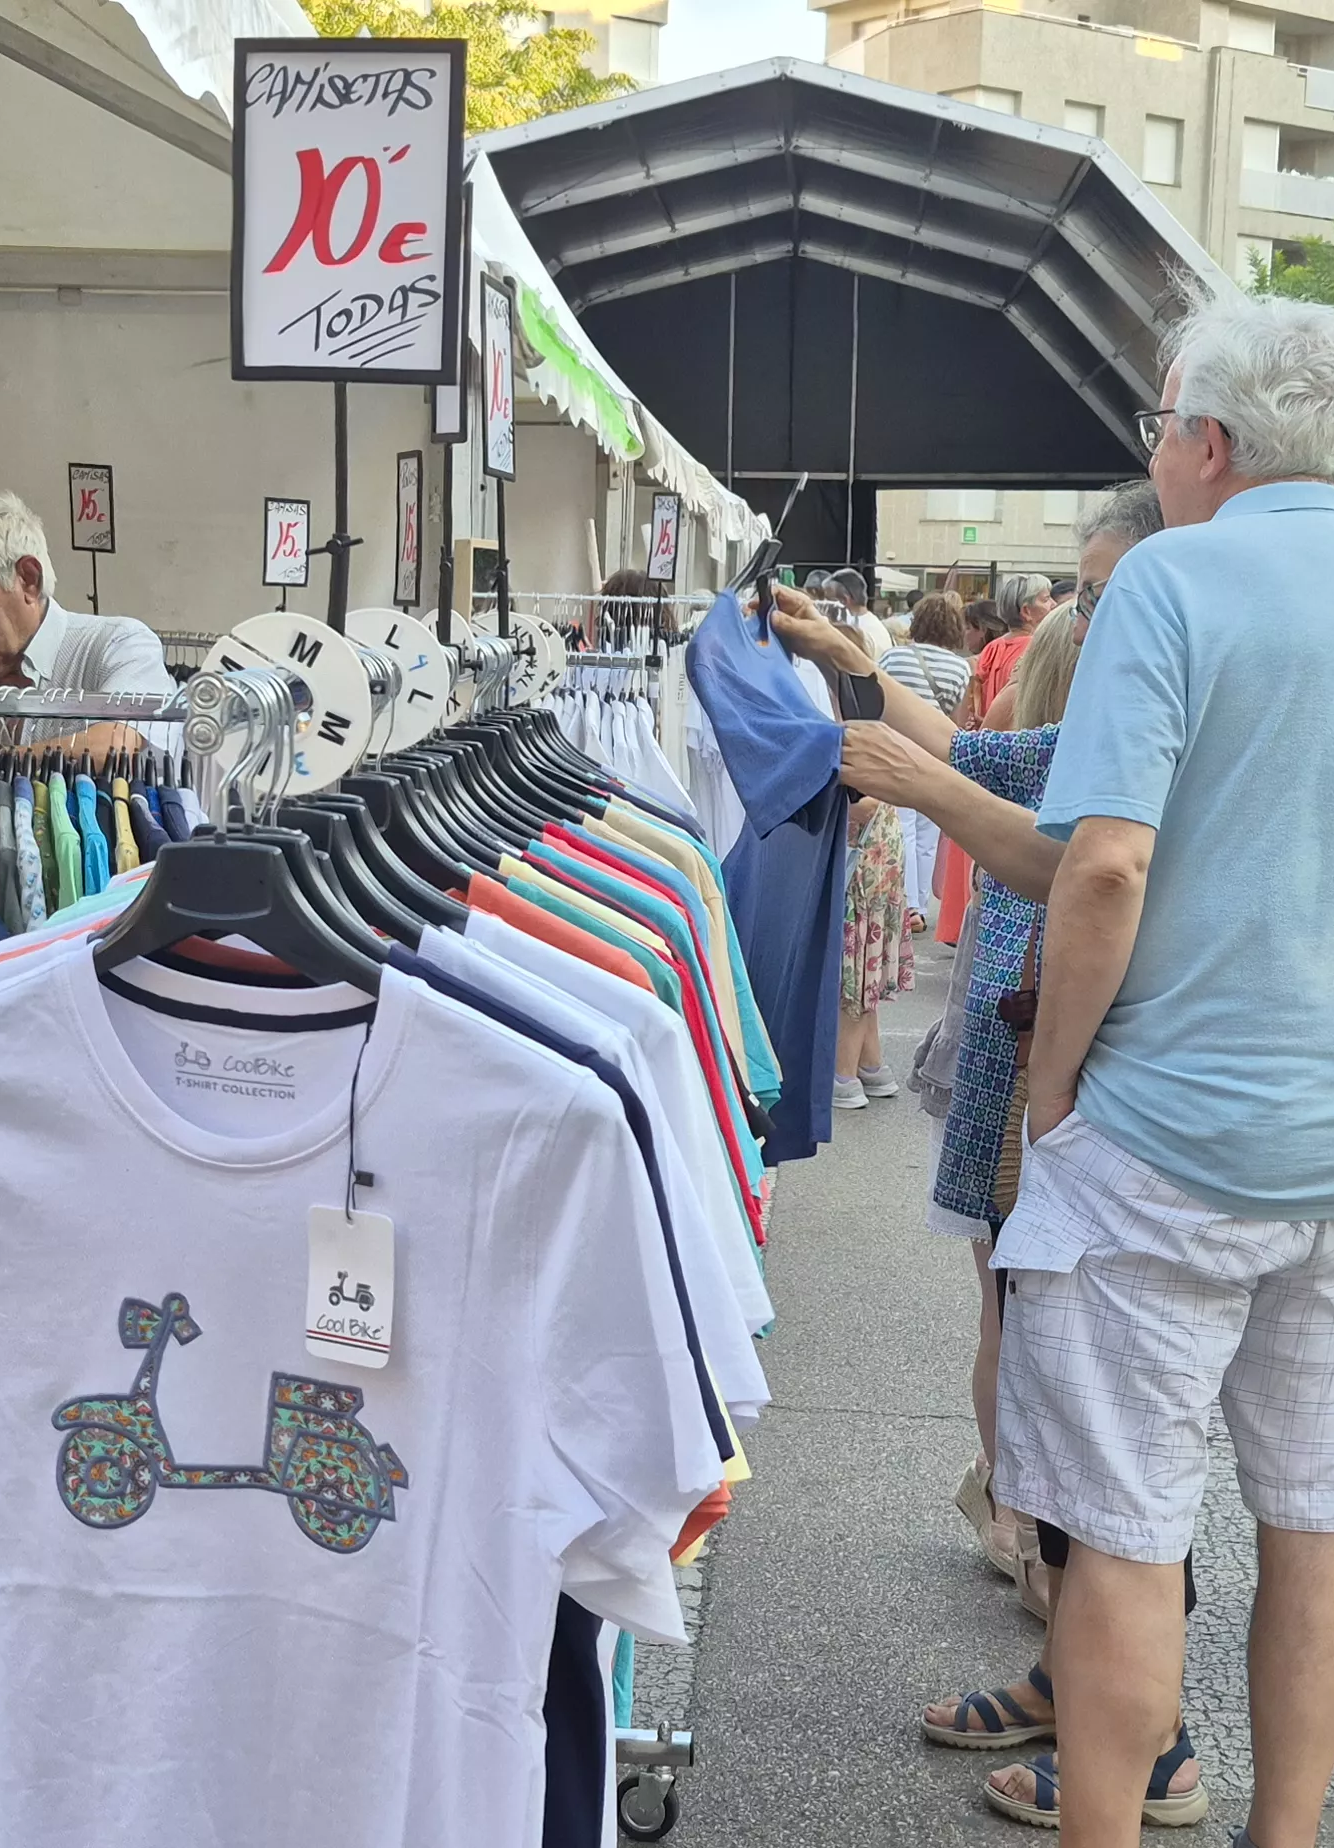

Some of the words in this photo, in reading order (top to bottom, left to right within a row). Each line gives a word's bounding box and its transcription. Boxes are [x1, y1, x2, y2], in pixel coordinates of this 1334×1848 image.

[278, 275, 442, 352] TODAS
[289, 632, 324, 668] M
[385, 624, 400, 650] L
[318, 711, 352, 746] M
[175, 1076, 219, 1091] T-SHIRT
[221, 1083, 296, 1100] COLLECTION
[316, 1313, 346, 1334] Cool
